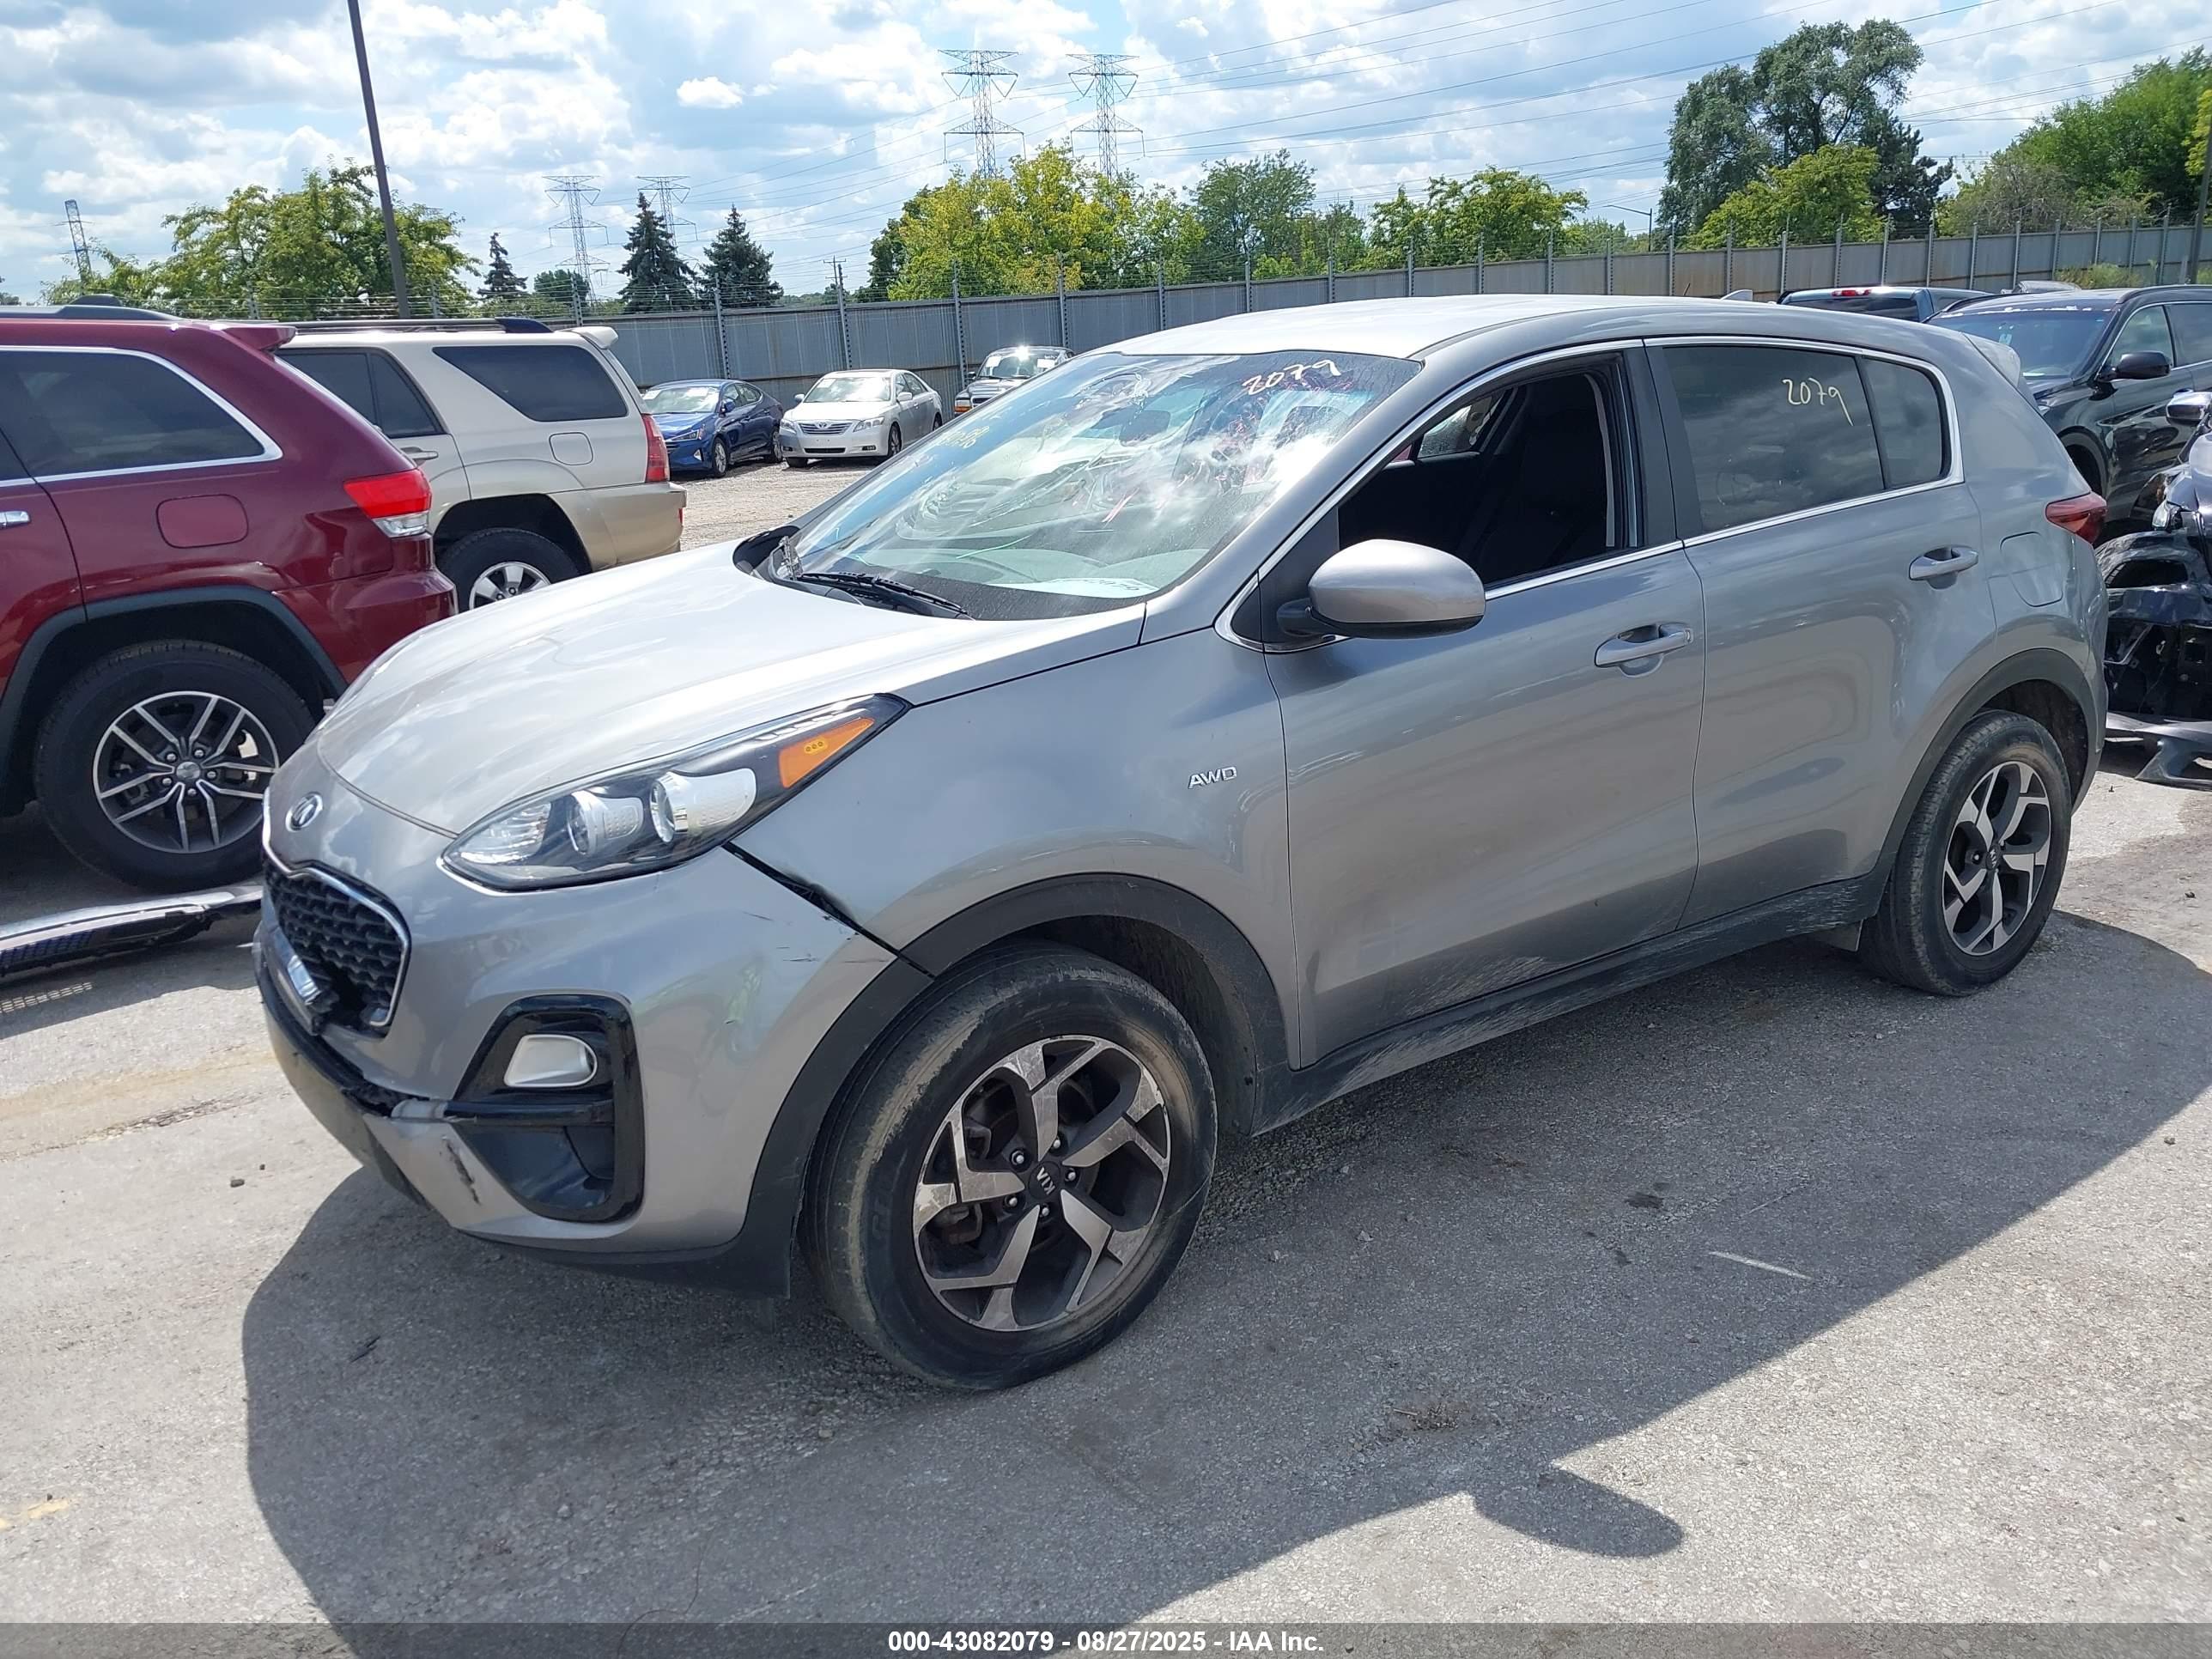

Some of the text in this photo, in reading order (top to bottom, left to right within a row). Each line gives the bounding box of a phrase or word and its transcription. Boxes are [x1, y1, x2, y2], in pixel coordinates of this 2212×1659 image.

[1242, 359, 1341, 395] 2079
[1782, 377, 1854, 427] 2079
[1188, 766, 1237, 789] AWD
[1036, 1166, 1056, 1195] KIA
